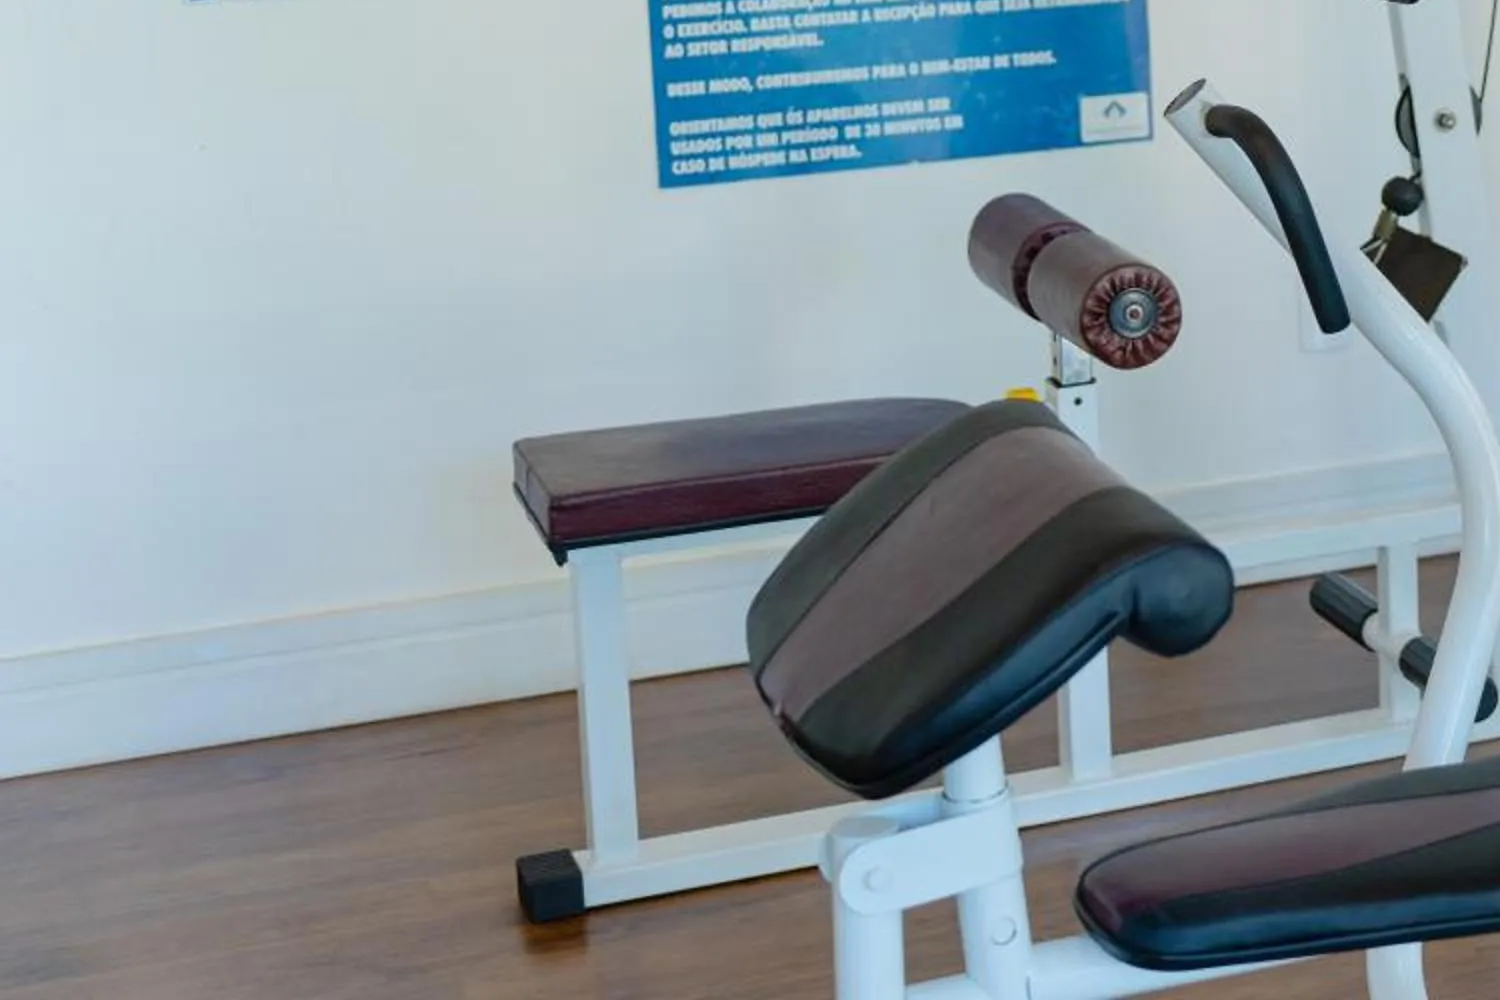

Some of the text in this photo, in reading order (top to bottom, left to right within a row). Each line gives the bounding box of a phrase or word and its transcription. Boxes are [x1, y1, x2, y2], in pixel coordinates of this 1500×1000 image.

[724, 0, 736, 12] A
[662, 24, 675, 37] O
[664, 44, 684, 57] AO
[908, 62, 919, 75] O
[724, 135, 753, 149] POR
[671, 159, 706, 174] CASO
